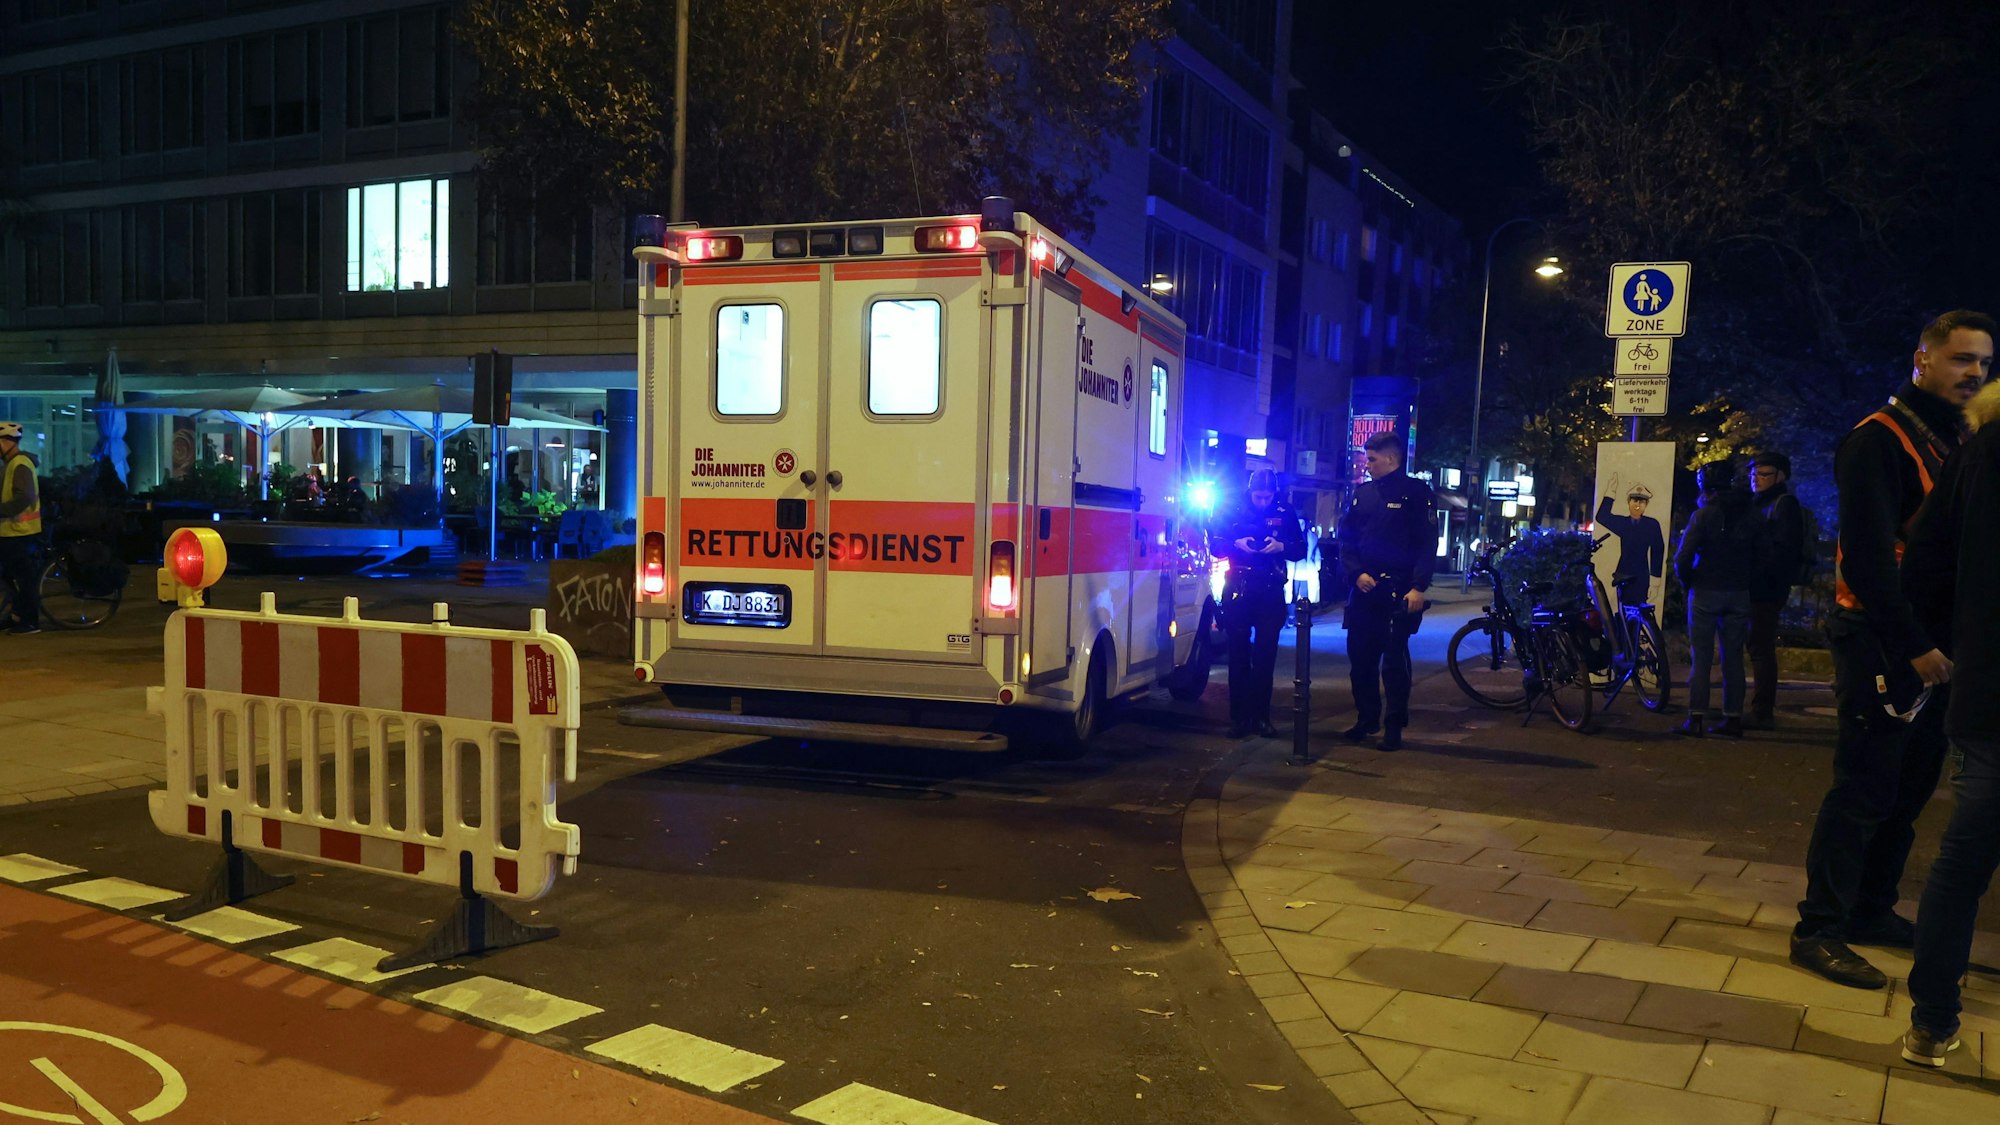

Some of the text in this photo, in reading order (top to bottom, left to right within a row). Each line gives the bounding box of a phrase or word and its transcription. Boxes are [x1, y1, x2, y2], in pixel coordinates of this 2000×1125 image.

[1626, 319, 1664, 331] ZONE
[1082, 336, 1093, 366] DIE
[1634, 362, 1651, 371] frei
[1079, 366, 1119, 405] JOHANNITER
[1624, 388, 1656, 396] werktags
[1632, 405, 1645, 413] frei
[695, 448, 714, 461] DIE
[691, 463, 765, 477] JOHANNITER
[691, 480, 765, 489] www.johanniter.de
[688, 529, 965, 564] RETTUNGSDIENST
[703, 594, 782, 613] K DJ 8831
